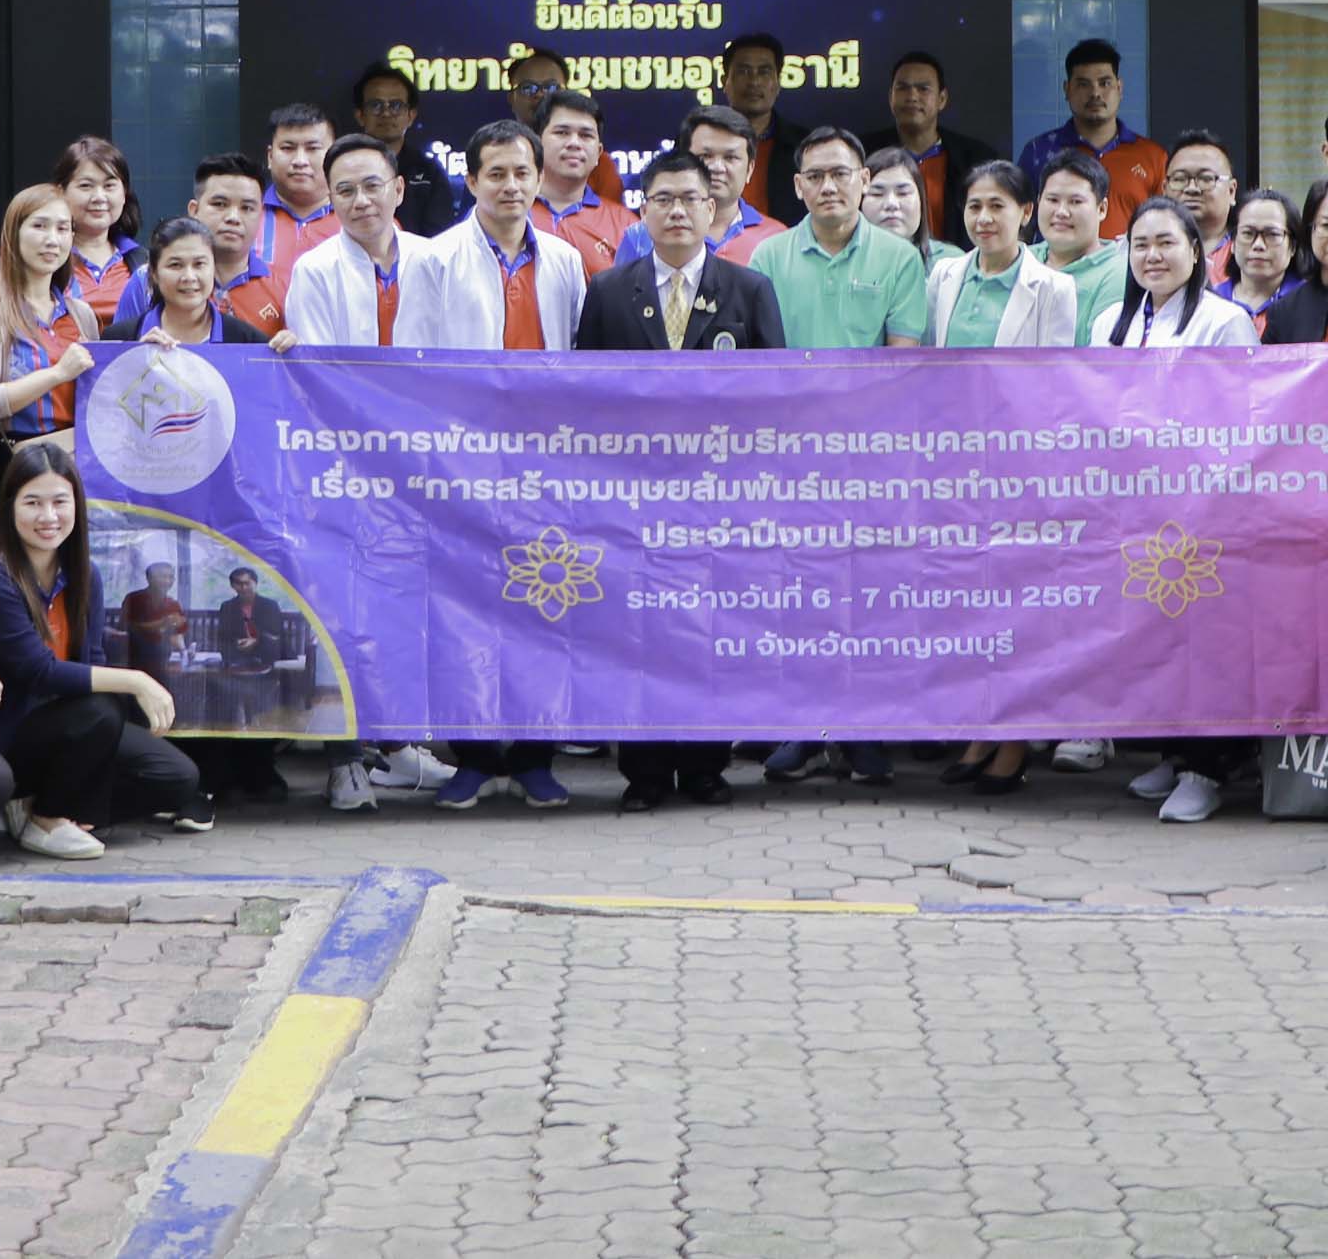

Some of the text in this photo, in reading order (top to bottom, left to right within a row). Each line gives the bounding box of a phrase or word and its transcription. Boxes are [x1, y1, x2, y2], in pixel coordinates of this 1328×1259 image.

[311, 461, 394, 500] เรื่อง
[642, 517, 1087, 550] ประจำปีงบประมาณ 2567
[625, 576, 803, 611] ระหว่างวันที่
[812, 586, 832, 609] 6
[862, 587, 879, 609] 7
[889, 584, 1013, 609] กันยายน
[1022, 585, 1102, 608] 2567
[715, 630, 1015, 663] ณ จังหวัดกาญจนบุรี
